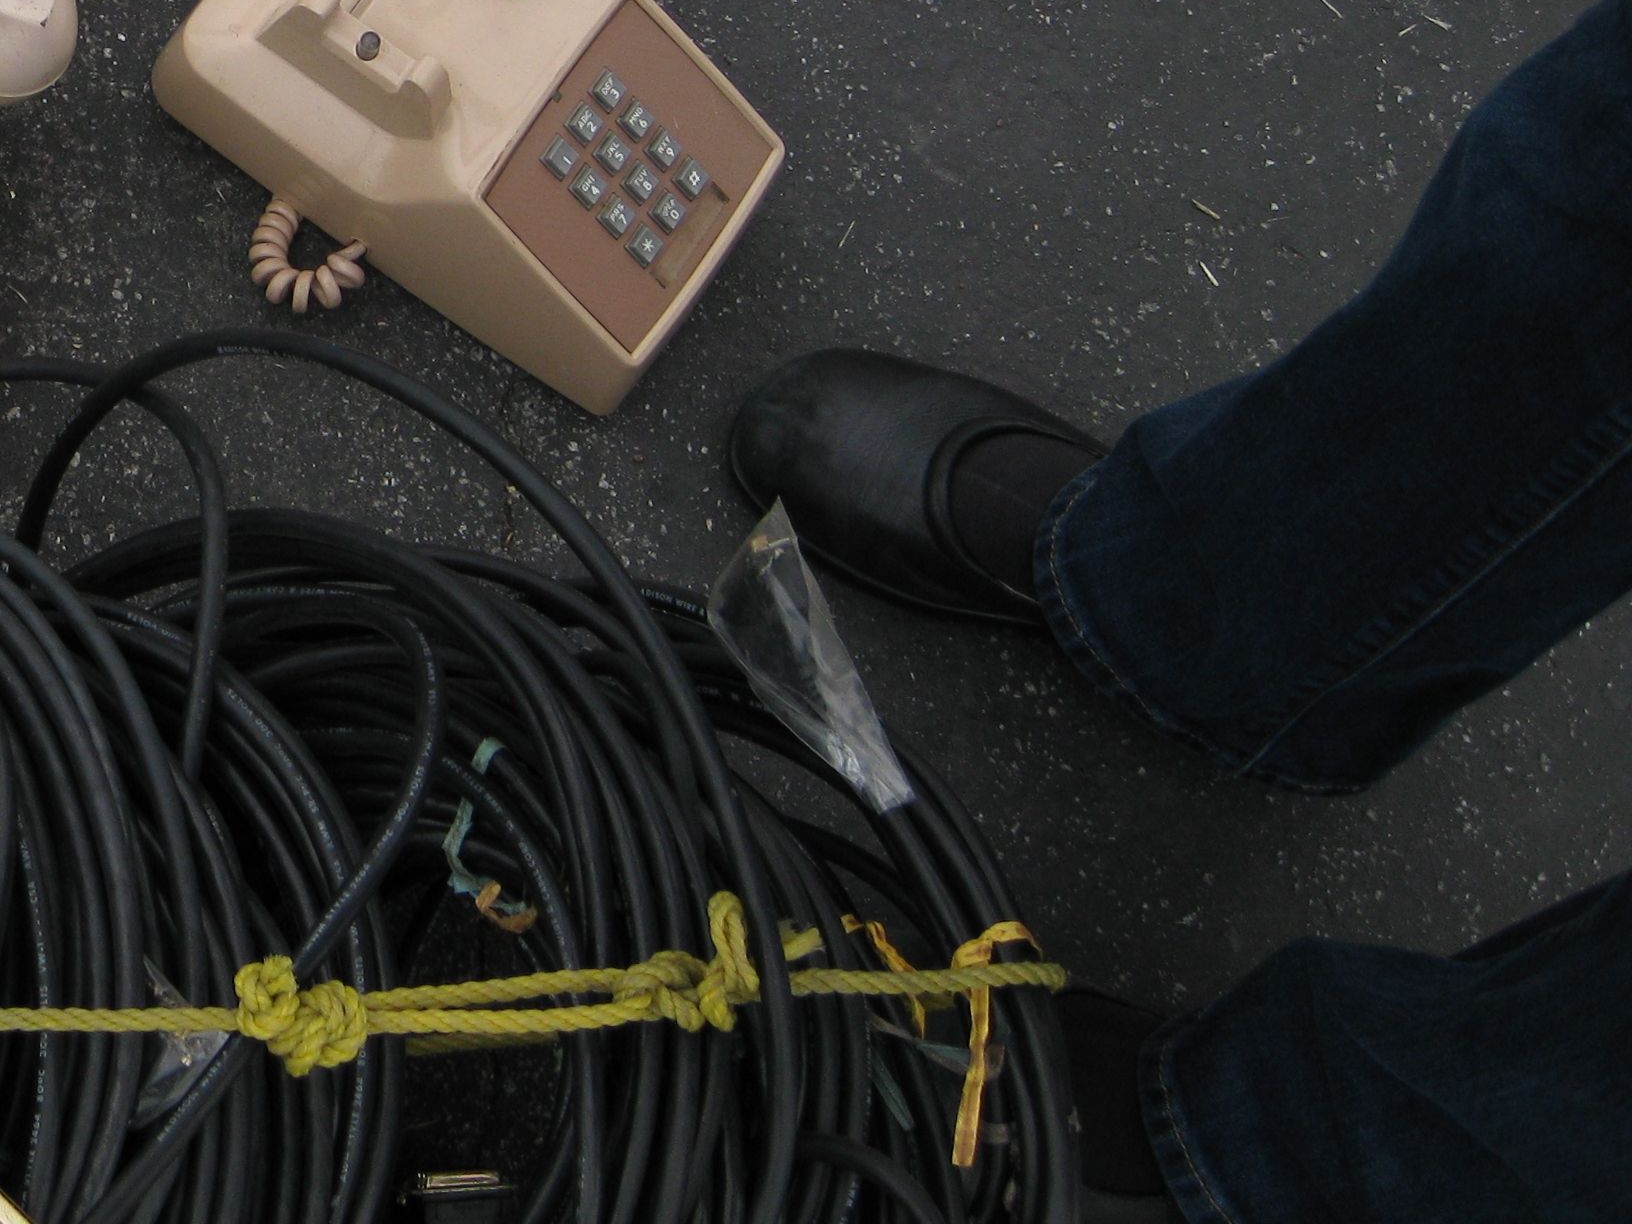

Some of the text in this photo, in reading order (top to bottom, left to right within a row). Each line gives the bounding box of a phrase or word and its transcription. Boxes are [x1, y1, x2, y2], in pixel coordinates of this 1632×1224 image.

[610, 88, 620, 100] 3
[586, 121, 597, 133] 2
[638, 119, 648, 129] 6
[614, 152, 625, 162] 5
[665, 147, 675, 158] 9
[590, 186, 600, 196] 4
[617, 213, 628, 226] 7
